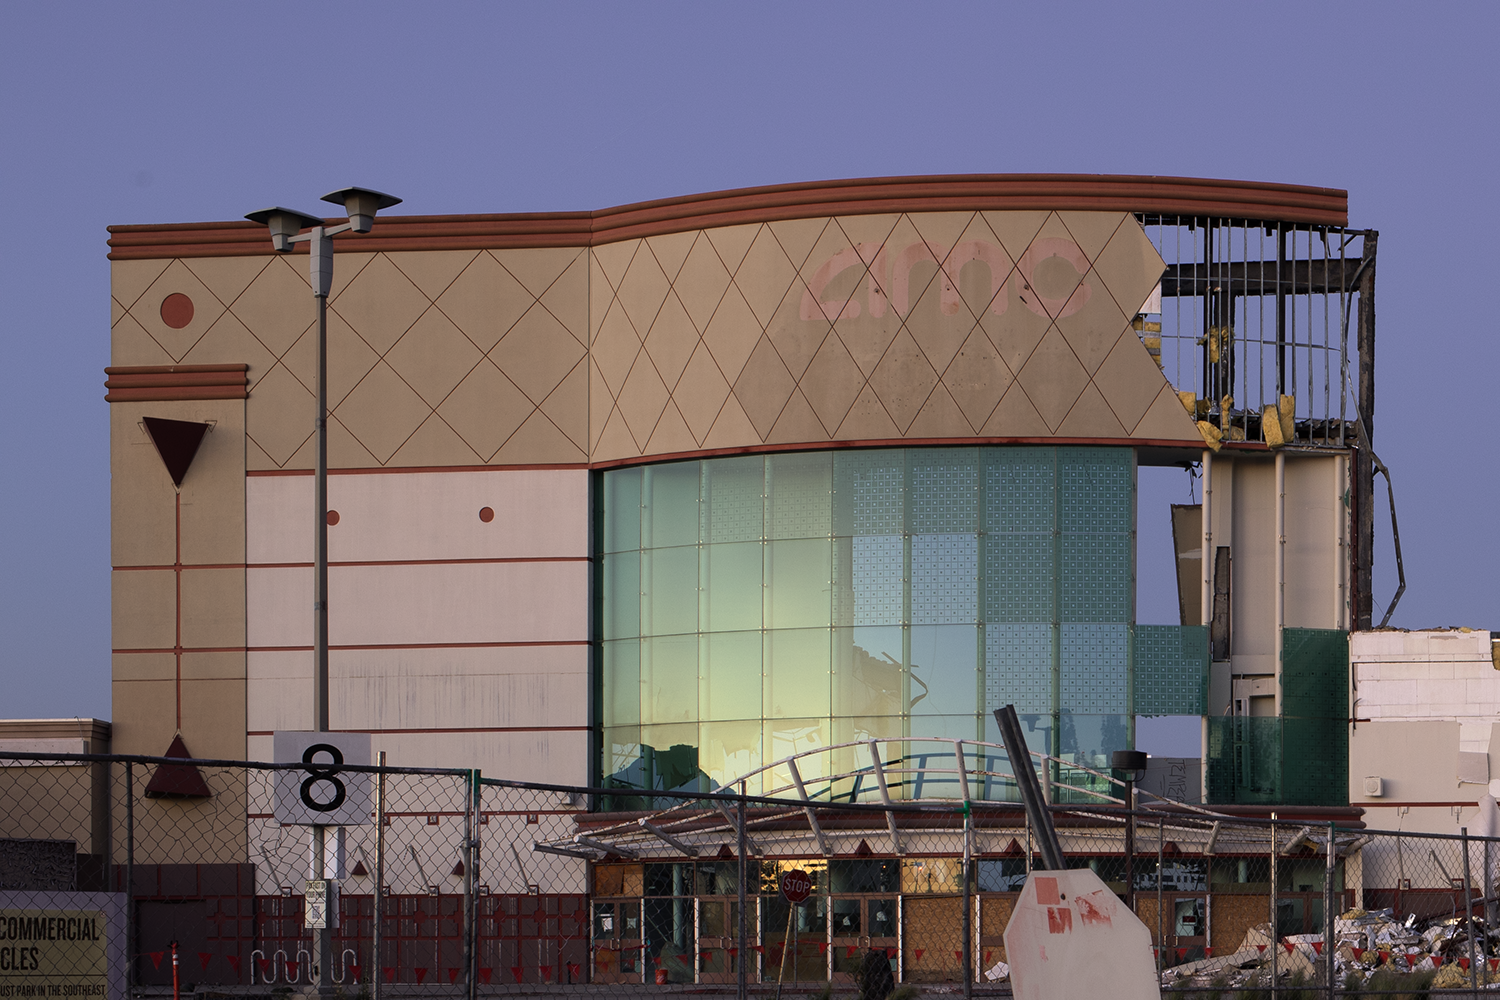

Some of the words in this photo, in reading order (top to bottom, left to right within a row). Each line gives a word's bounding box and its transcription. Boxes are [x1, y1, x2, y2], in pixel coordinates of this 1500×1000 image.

[800, 237, 1092, 321] amc
[300, 743, 346, 811] 8
[784, 878, 810, 893] STOP
[16, 985, 36, 997] PARK
[37, 985, 46, 997] IN
[47, 984, 61, 996] THE
[63, 984, 106, 996] SOUTHEAST
